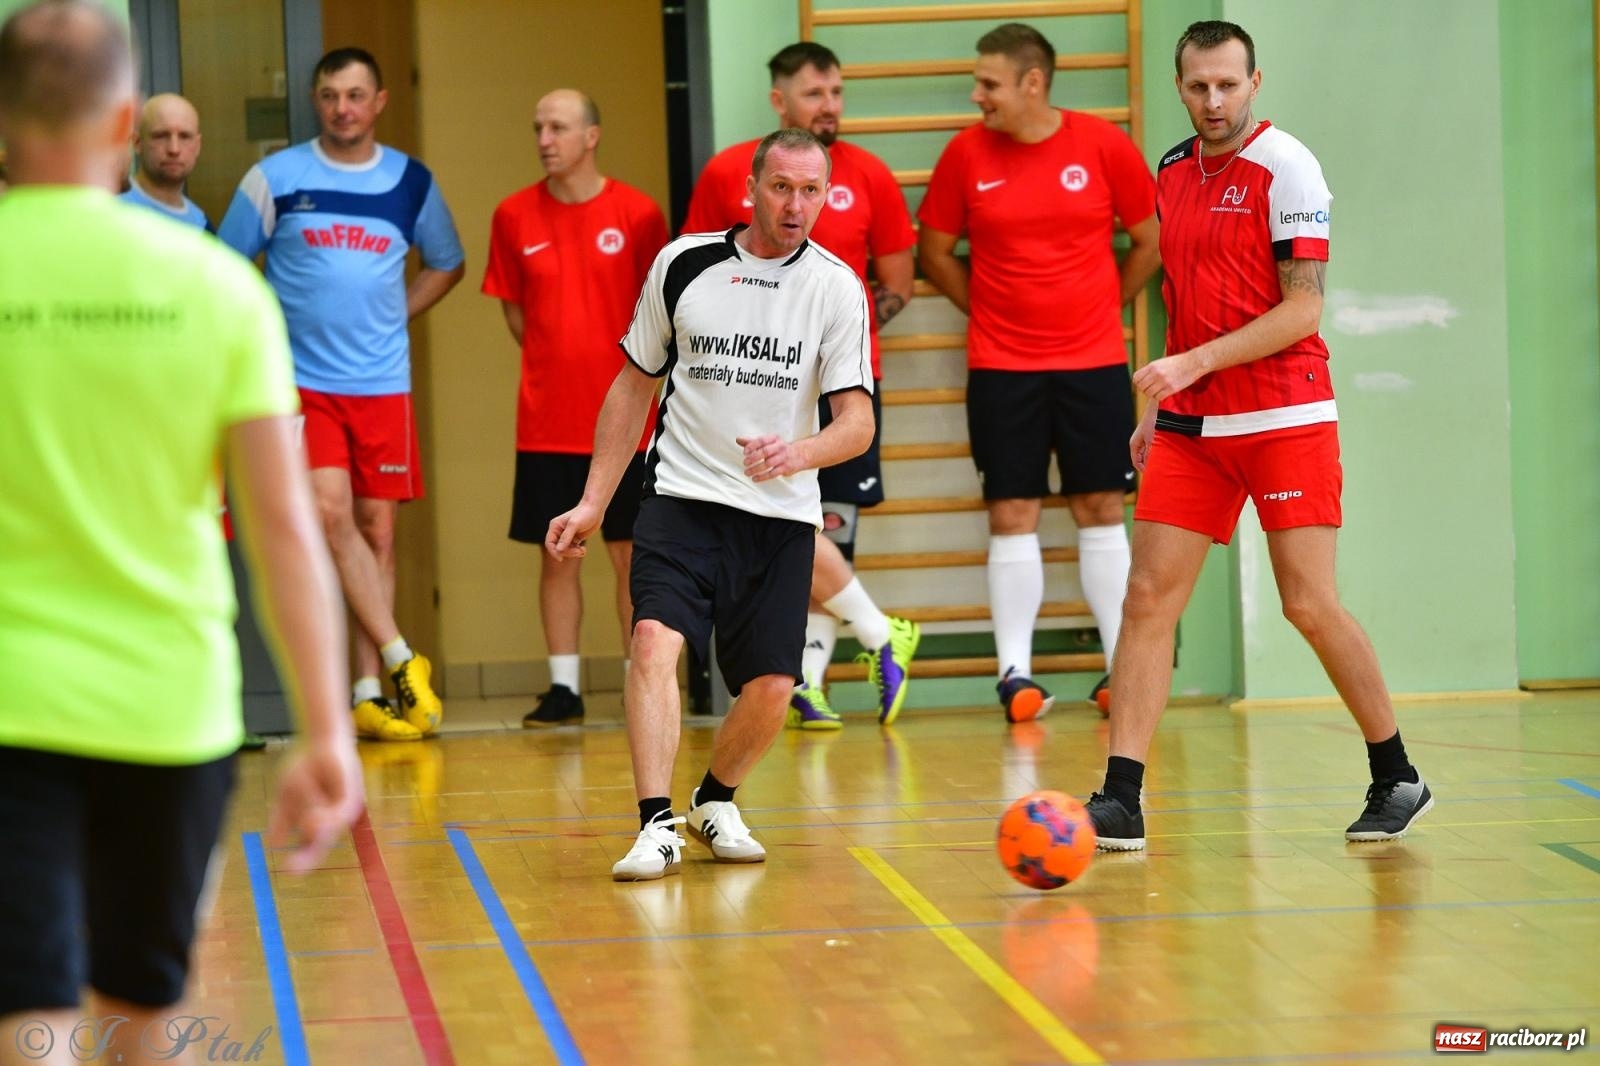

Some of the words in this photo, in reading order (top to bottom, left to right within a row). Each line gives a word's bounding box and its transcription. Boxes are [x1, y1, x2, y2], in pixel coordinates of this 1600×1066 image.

[741, 276, 780, 290] PATRICK
[689, 333, 803, 370] www.IKSAL.pl
[688, 364, 734, 387] materiały
[735, 366, 799, 391] budowlane
[1263, 490, 1303, 501] regio
